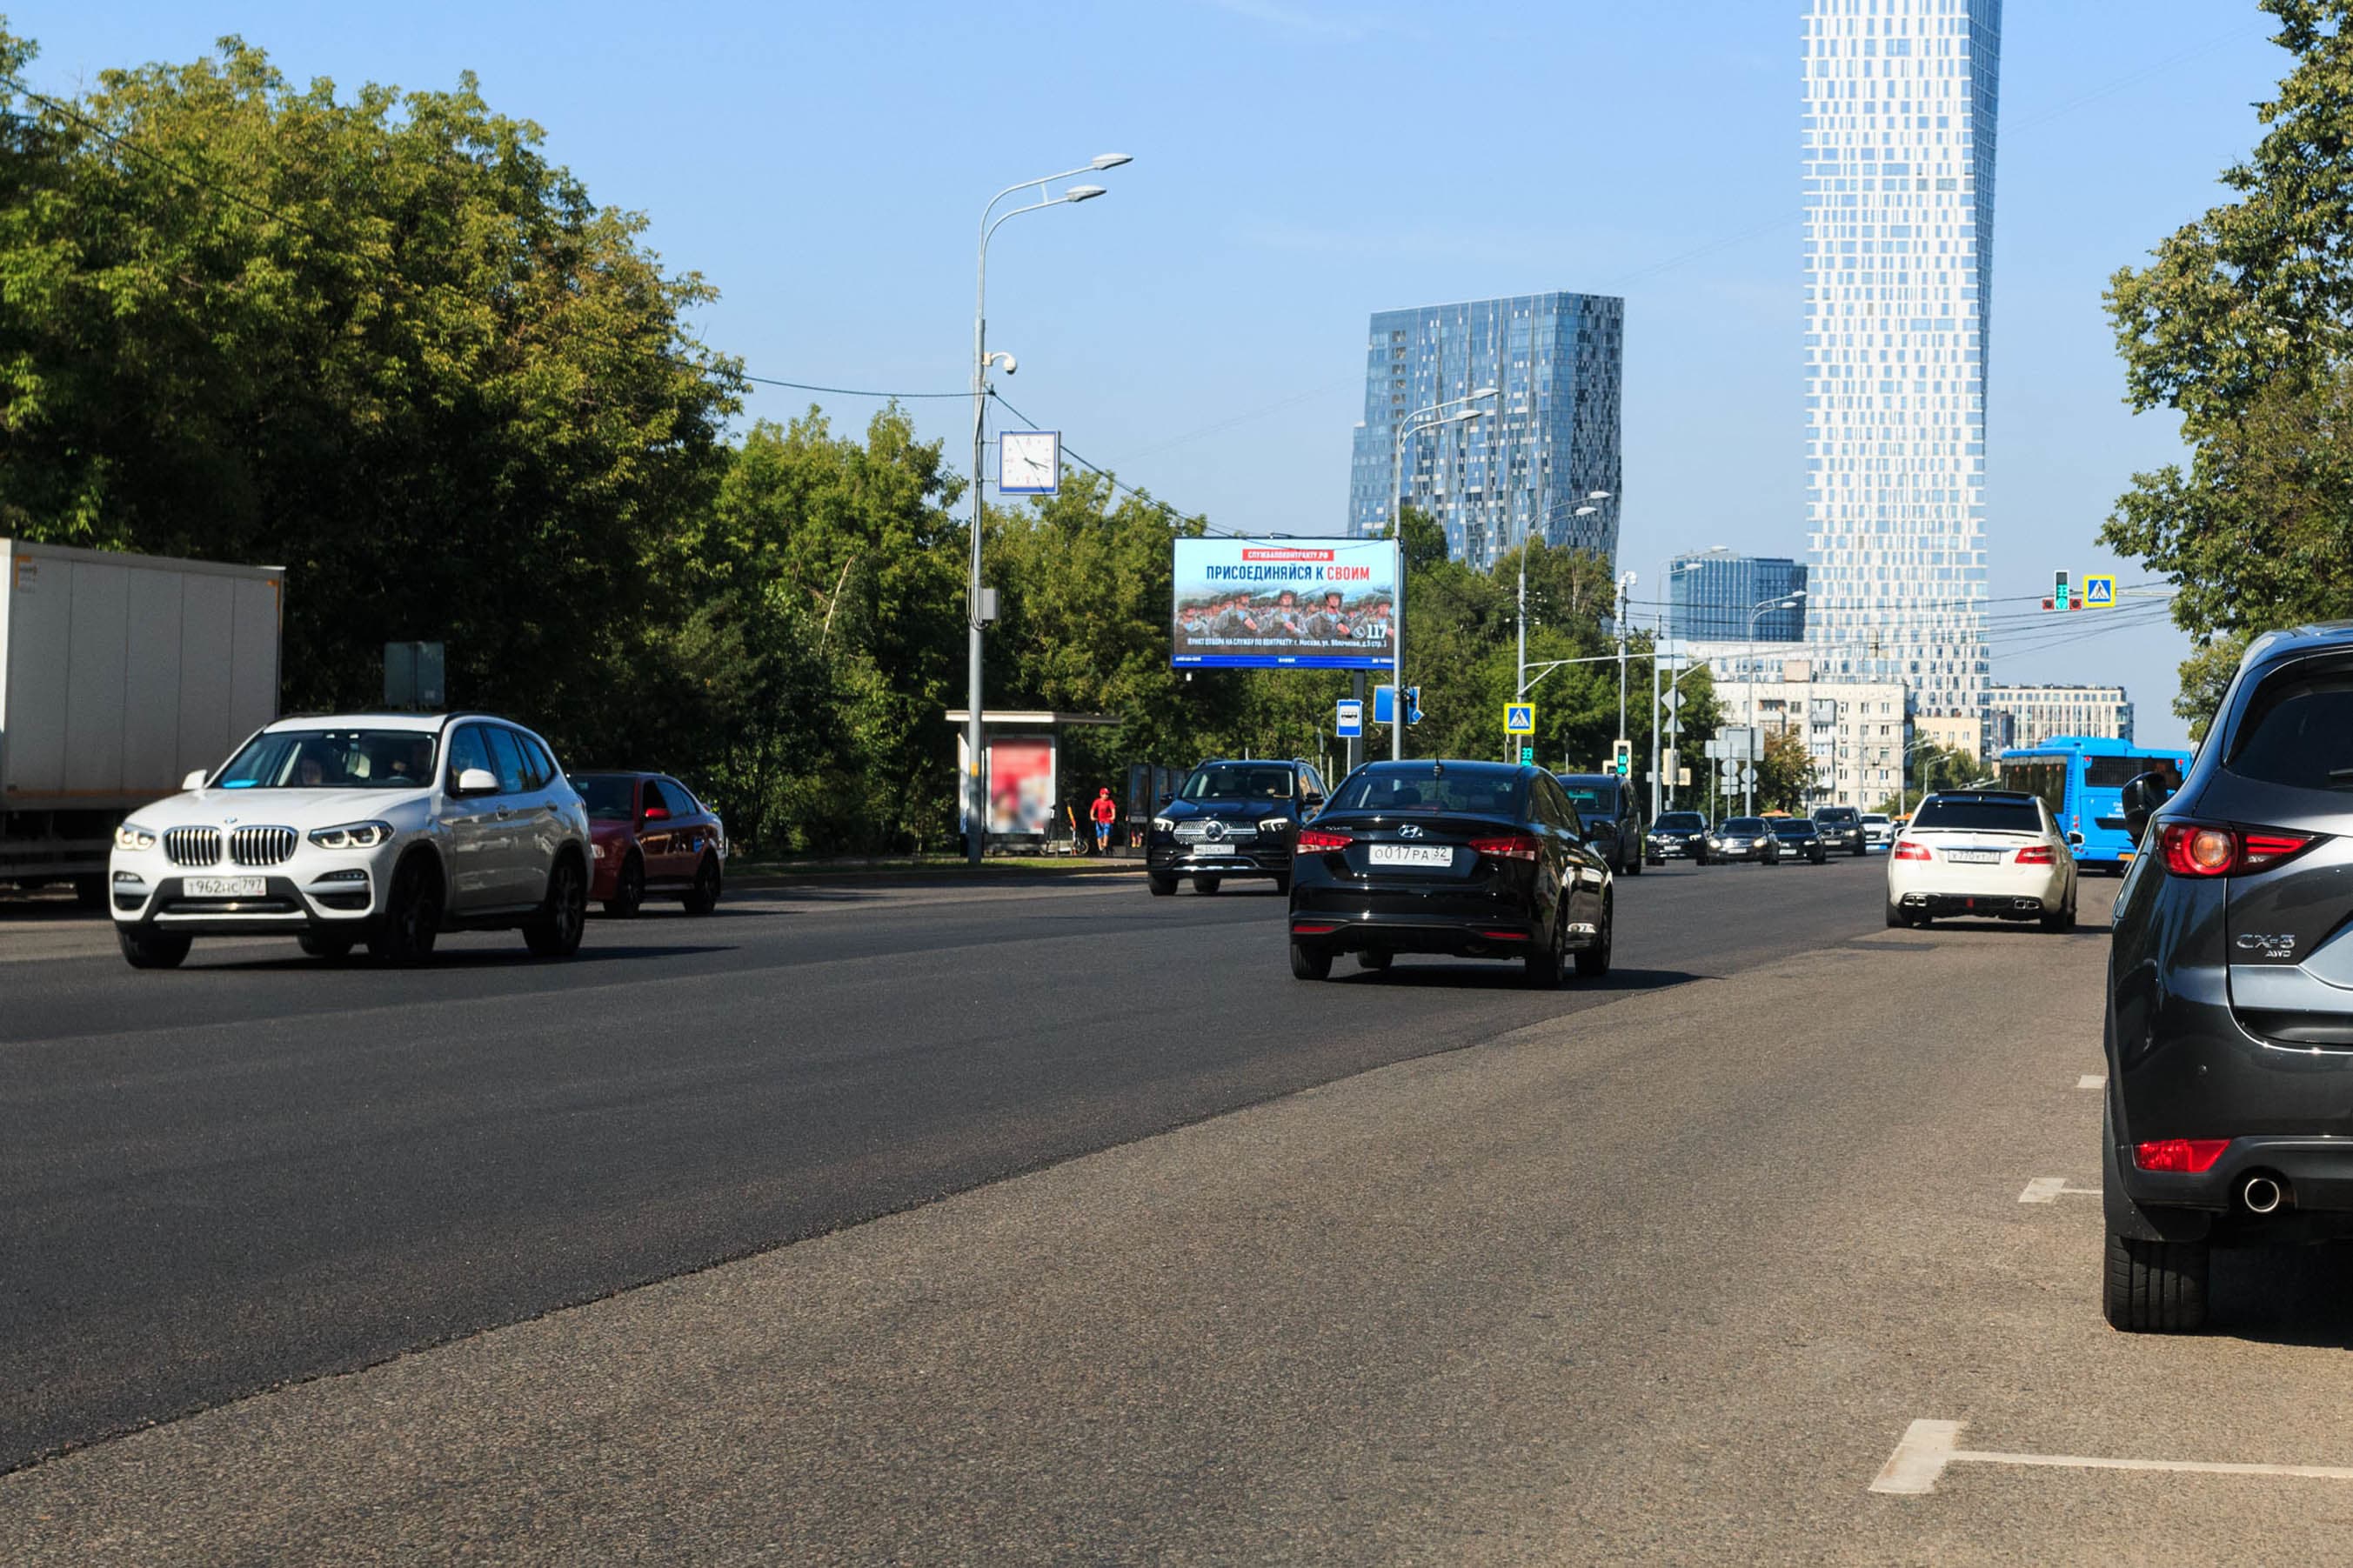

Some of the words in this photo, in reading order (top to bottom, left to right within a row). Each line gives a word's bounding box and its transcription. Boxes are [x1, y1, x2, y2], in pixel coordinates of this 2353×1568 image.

[1207, 564, 1312, 581] ПРИСОЕДИНЯЙСЯ
[1316, 567, 1324, 580] К
[1327, 566, 1370, 581] СВОИМ
[1367, 624, 1387, 639] 117
[2236, 933, 2296, 949] CX-5
[2264, 950, 2292, 958] AWD
